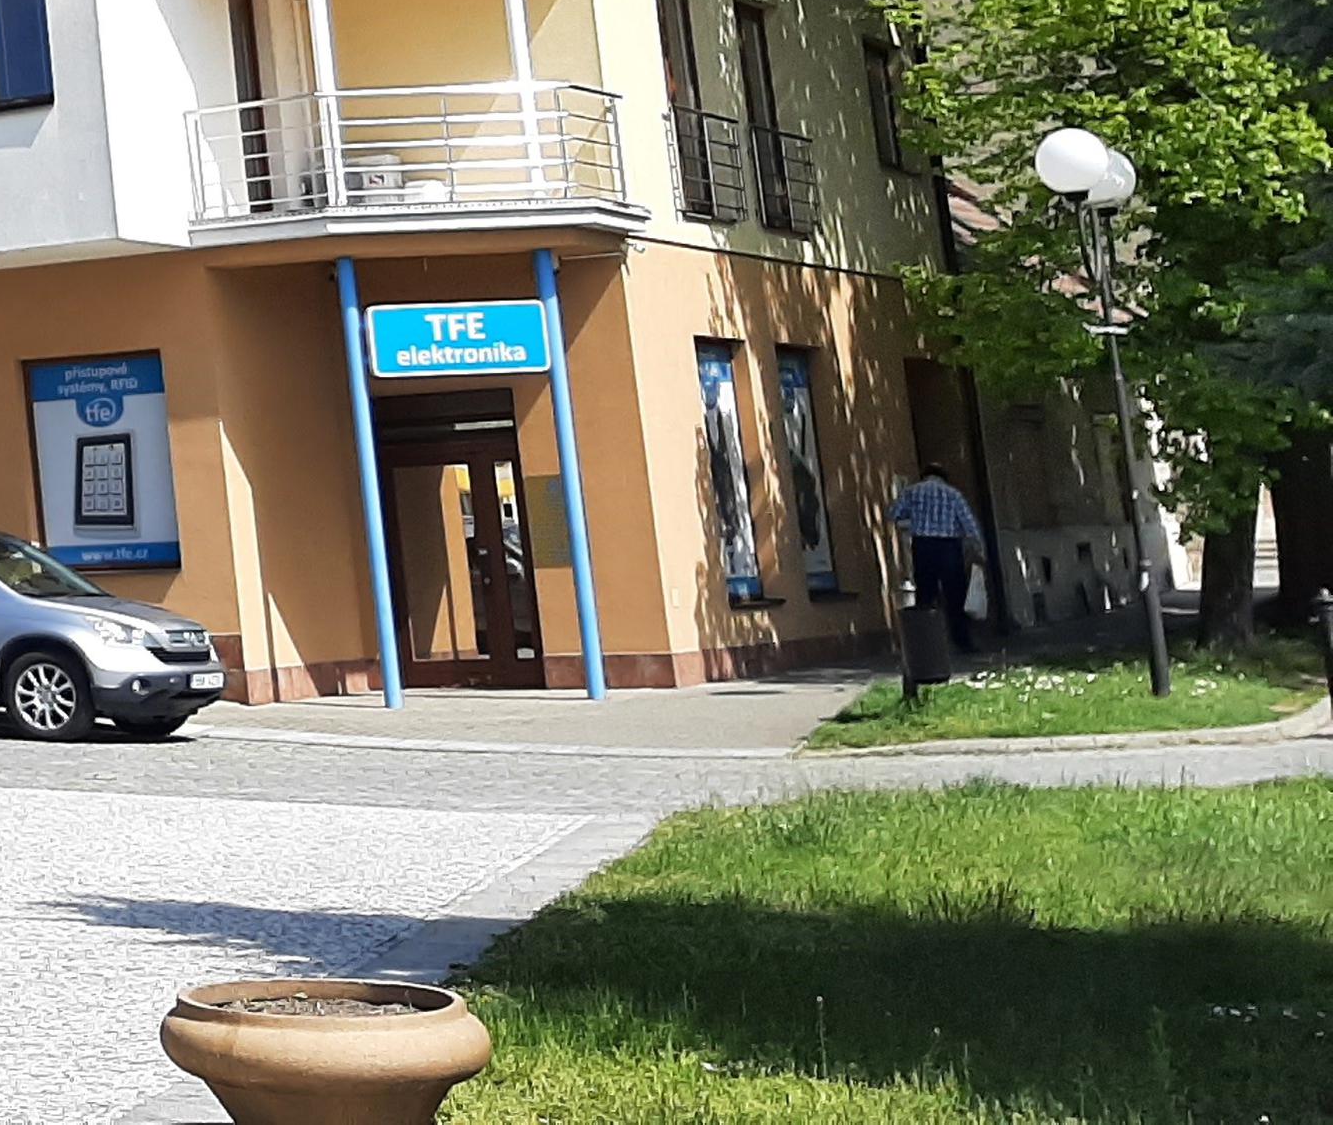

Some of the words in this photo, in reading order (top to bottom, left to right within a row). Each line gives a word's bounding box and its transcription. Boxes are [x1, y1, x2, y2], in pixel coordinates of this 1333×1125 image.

[424, 312, 486, 341] TFE
[396, 341, 528, 366] elektronika
[85, 402, 113, 423] tfe
